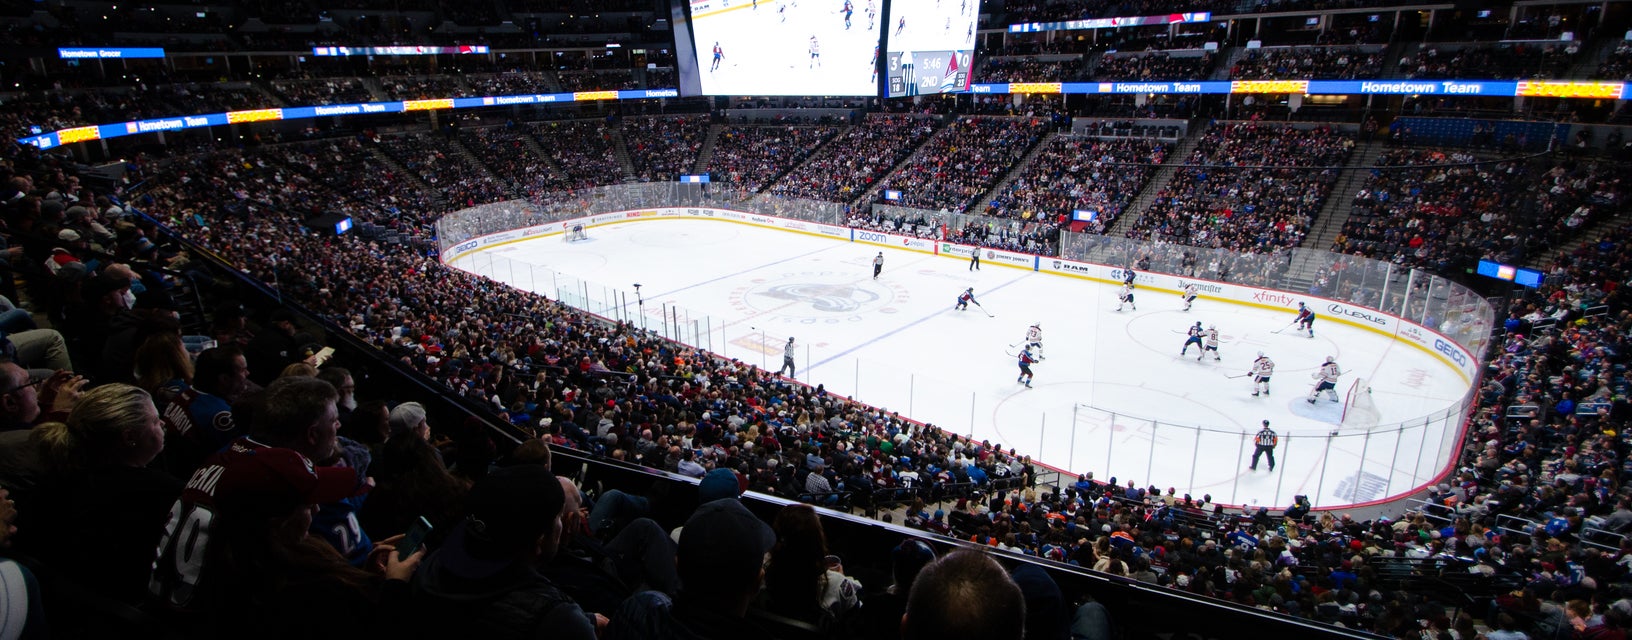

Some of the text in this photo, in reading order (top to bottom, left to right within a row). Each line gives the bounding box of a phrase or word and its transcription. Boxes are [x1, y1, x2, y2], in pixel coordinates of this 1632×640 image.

[891, 56, 898, 71] 3
[923, 58, 941, 70] 5:46
[963, 54, 970, 68] 0
[892, 84, 900, 92] 18
[921, 76, 938, 88] 2ND
[971, 84, 991, 92] Team
[1116, 82, 1201, 93] Hometown Team
[1361, 81, 1480, 94] Hometown Team
[496, 93, 555, 104] Hometown Team
[315, 103, 385, 117] Hometown Team
[139, 115, 208, 132] Hometown Team
[859, 231, 887, 243] zoom
[909, 238, 925, 248] pepsi
[455, 240, 478, 253] GEICO
[1063, 264, 1089, 272] RAM
[1253, 291, 1294, 307] xfinity
[1343, 308, 1386, 326] LEXUS
[1434, 339, 1466, 368] GEICO
[1260, 361, 1271, 371] 25
